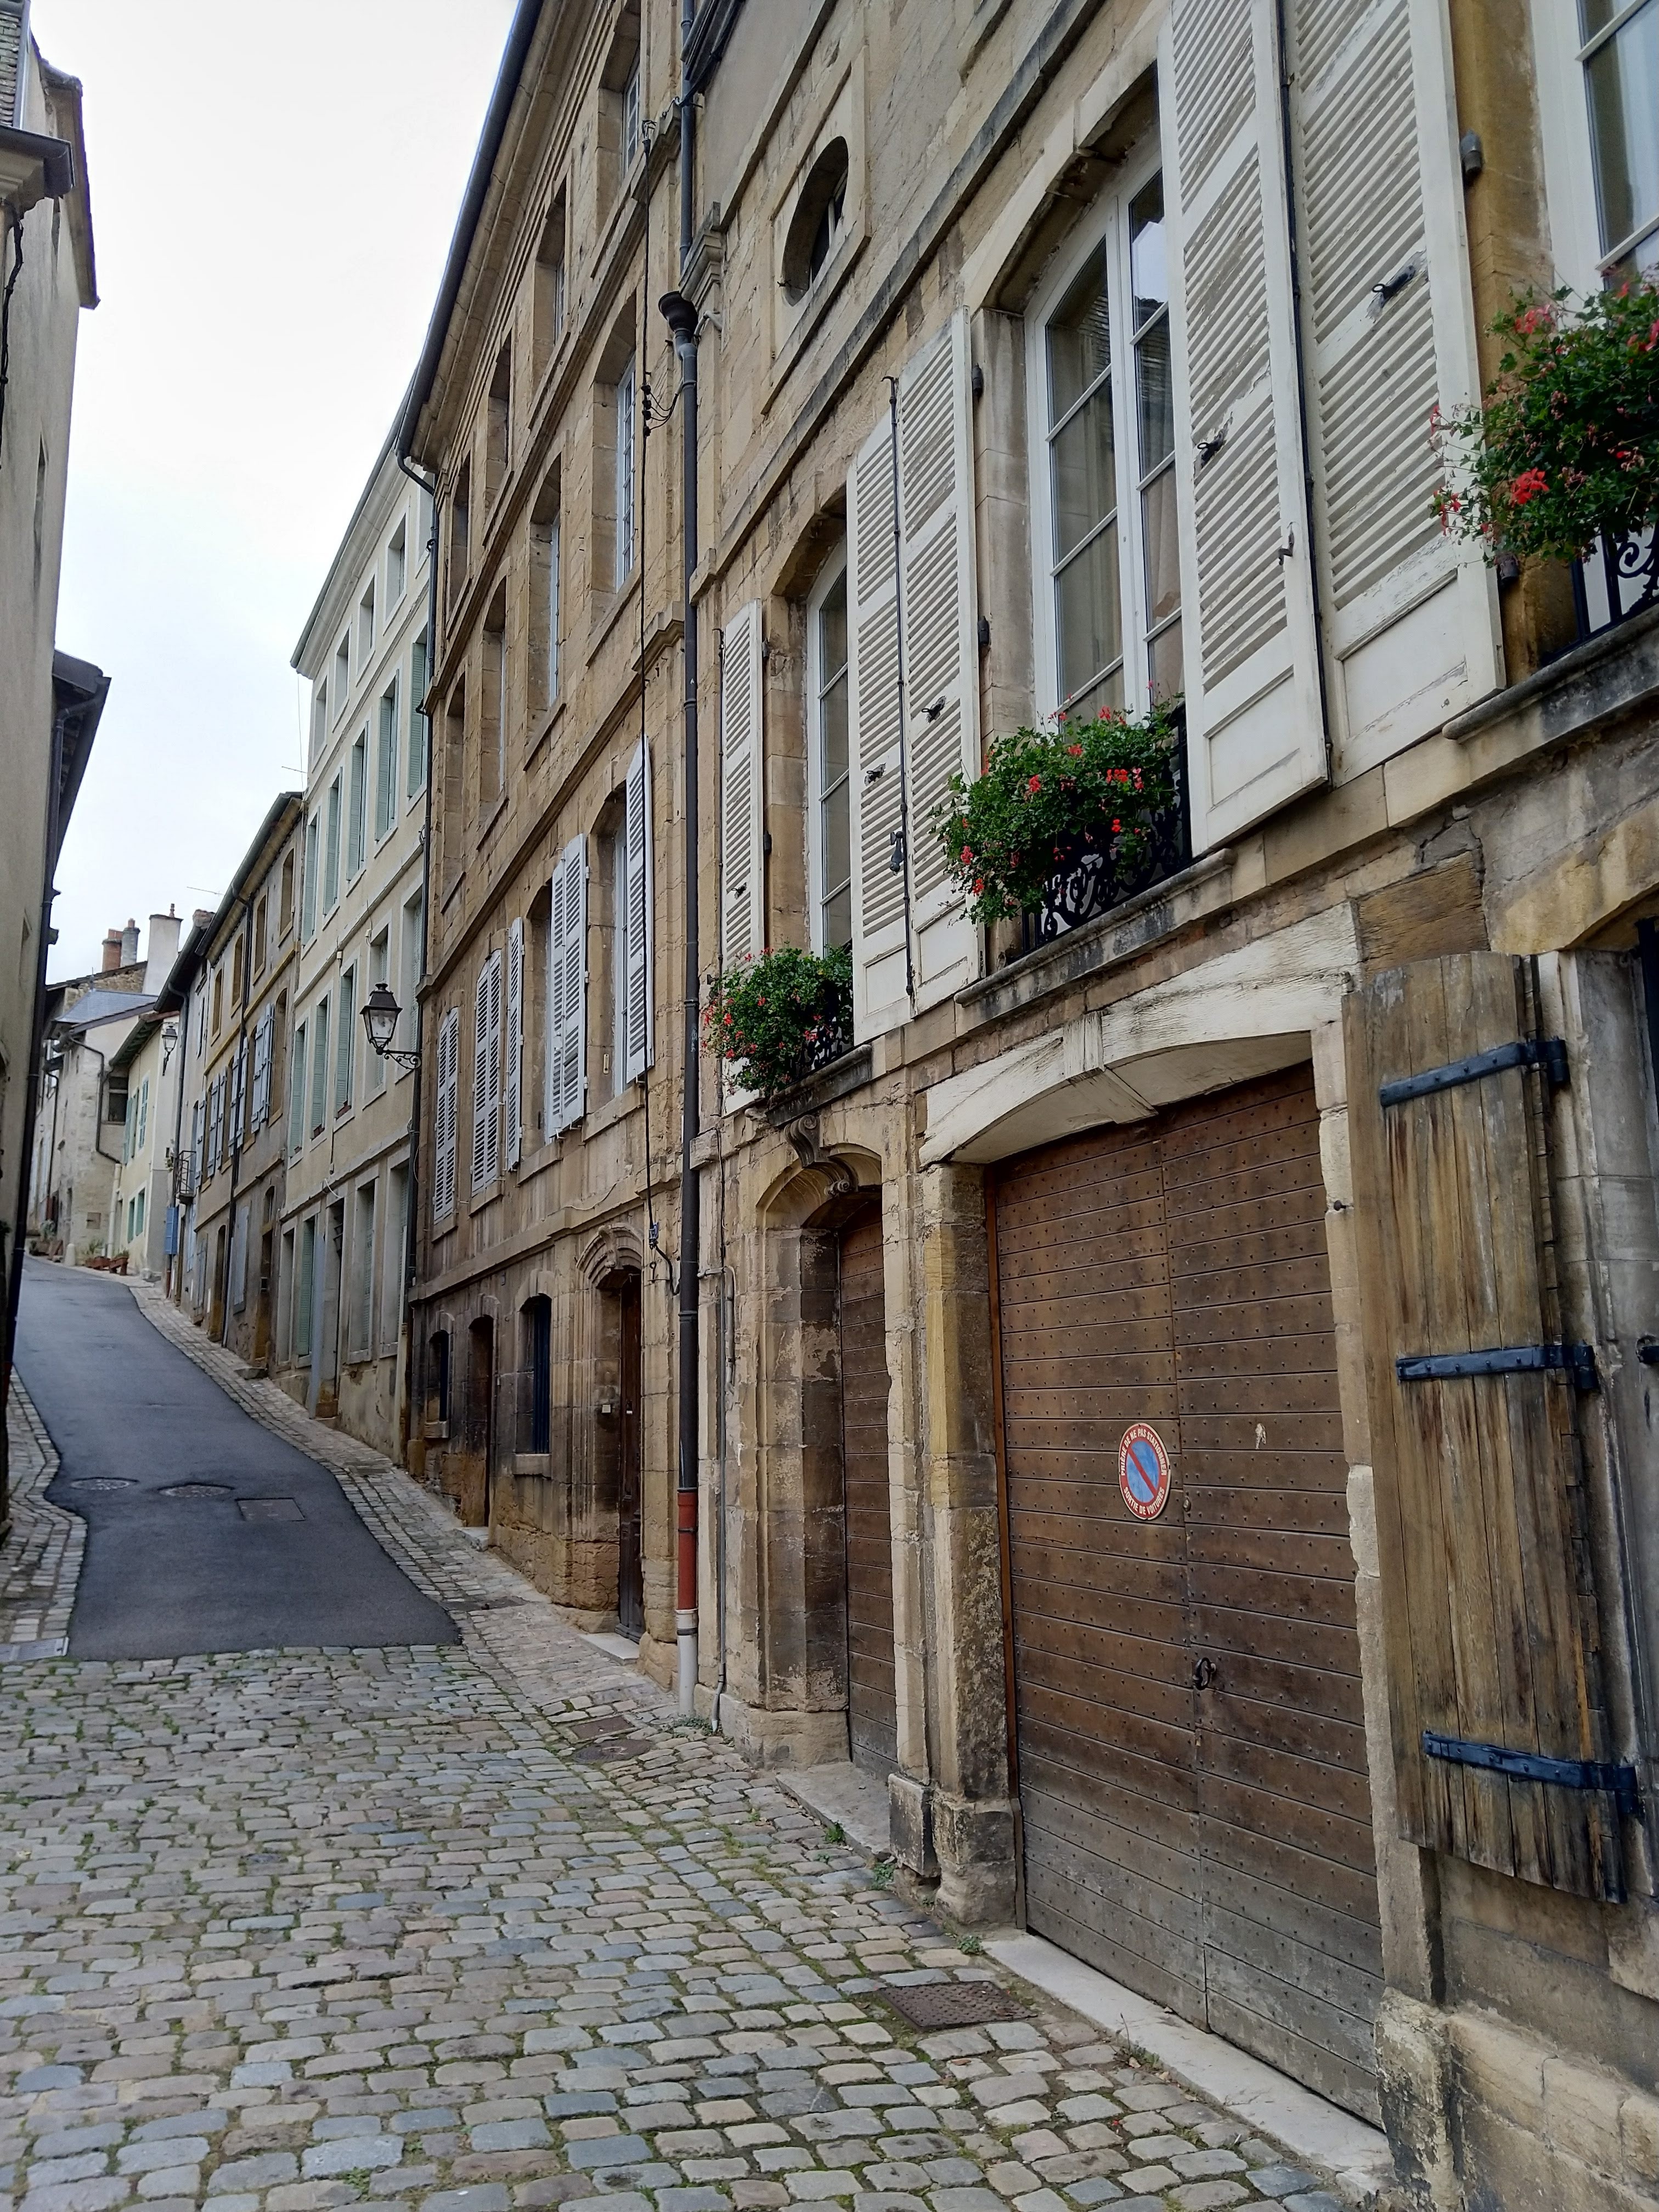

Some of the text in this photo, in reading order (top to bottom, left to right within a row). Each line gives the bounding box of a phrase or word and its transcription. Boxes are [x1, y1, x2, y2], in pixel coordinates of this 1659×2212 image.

[1124, 1436, 1131, 1448] DE
[1130, 1429, 1137, 1441] NE
[1137, 1429, 1146, 1437] PAS
[1147, 1431, 1167, 1475] STATIONNER
[1124, 1487, 1165, 1515] SORTIE DE VOITURES
